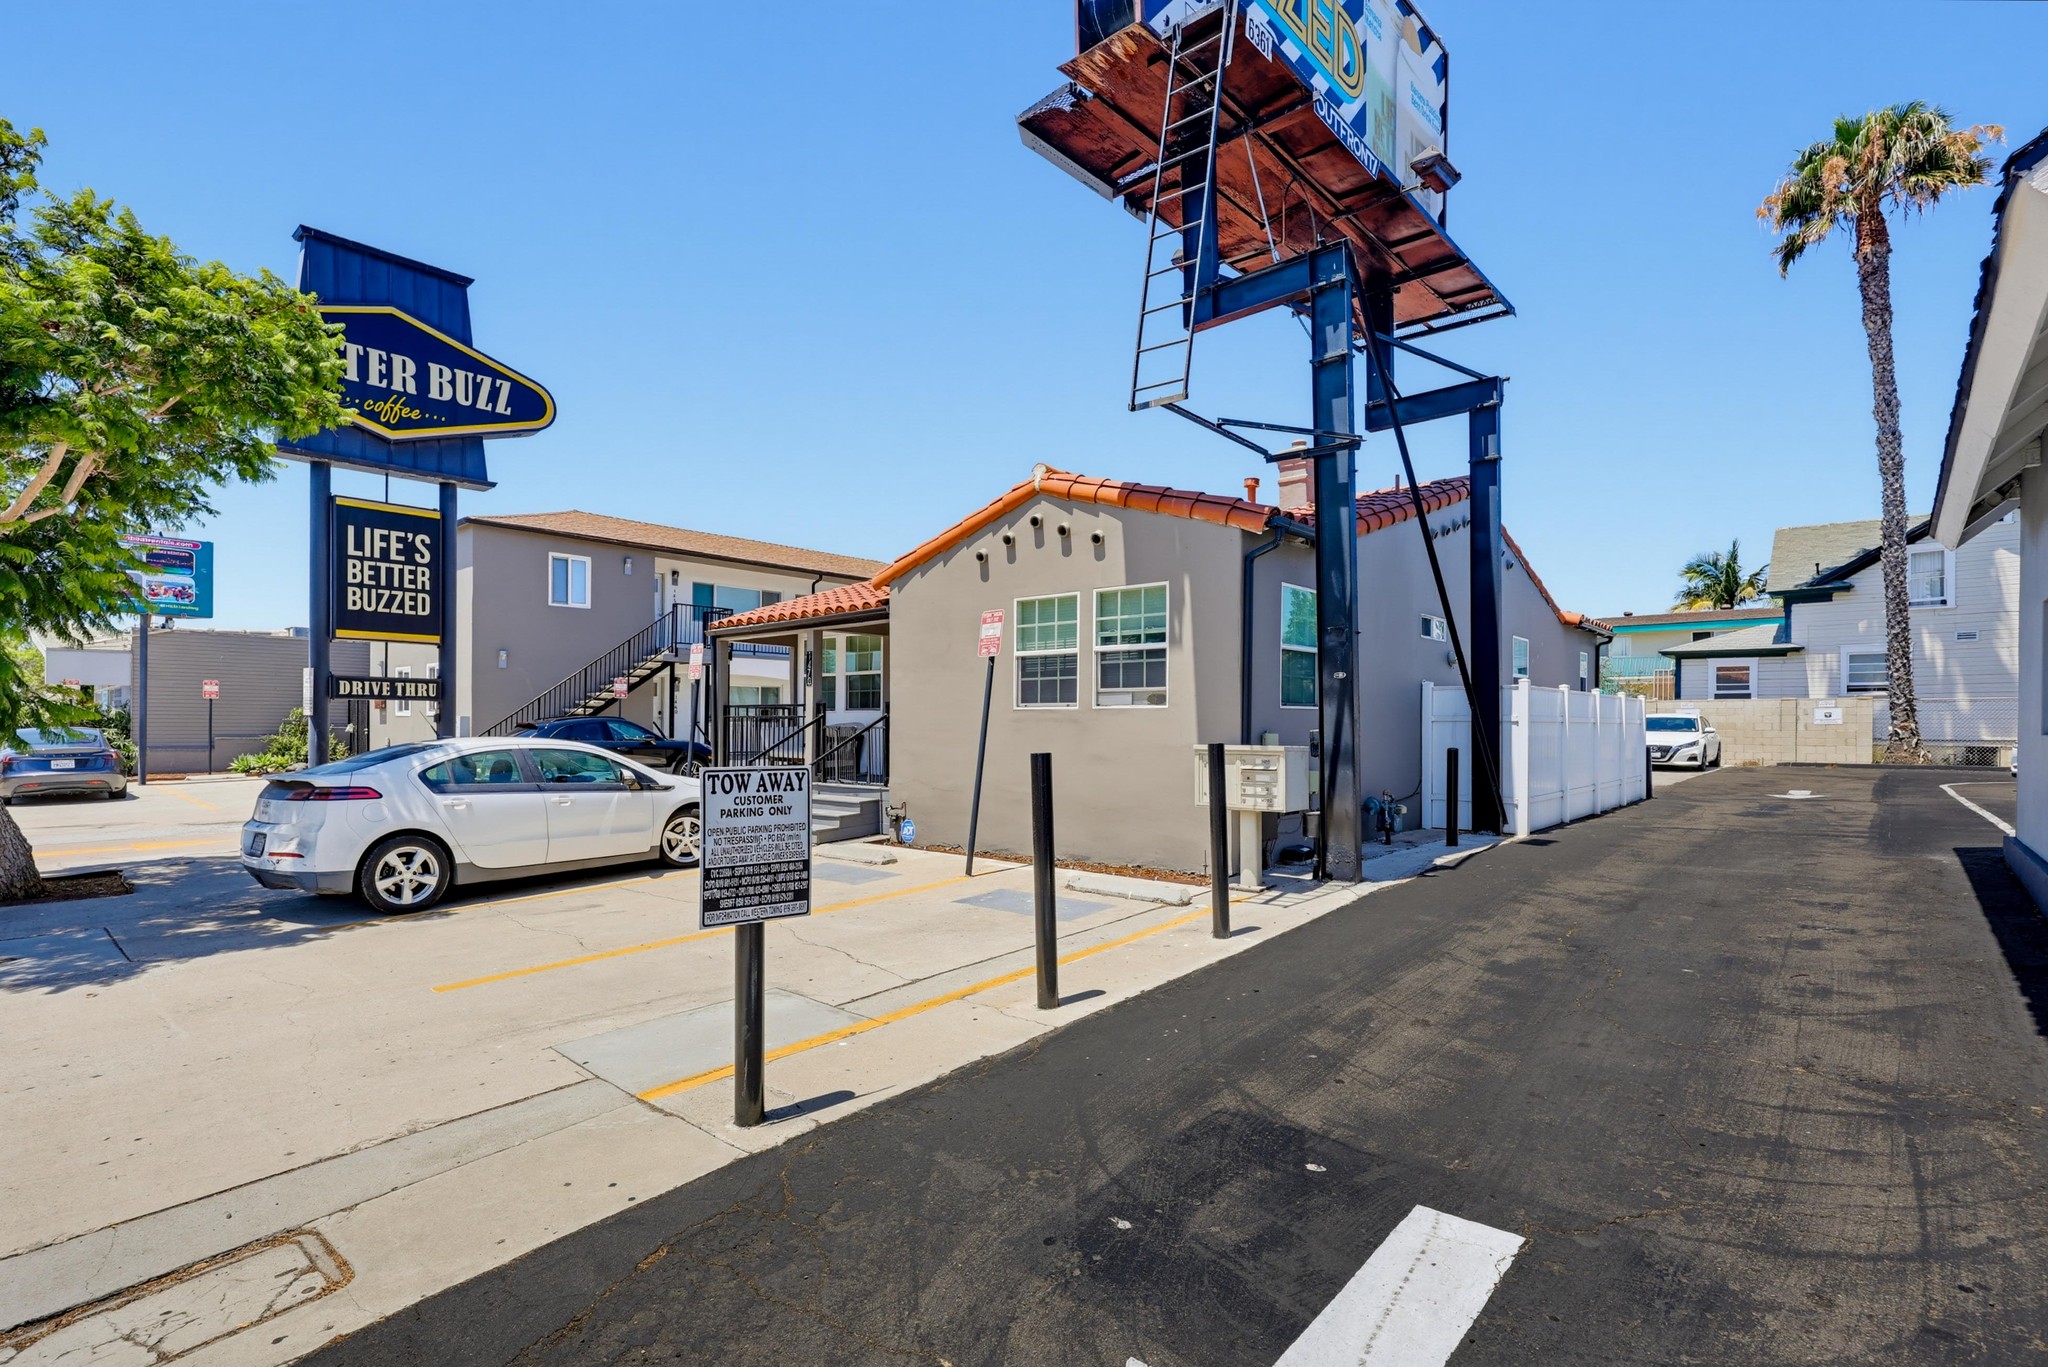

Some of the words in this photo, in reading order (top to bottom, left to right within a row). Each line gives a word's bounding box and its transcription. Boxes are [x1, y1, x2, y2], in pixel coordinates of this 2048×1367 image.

[1249, 18, 1271, 59] 6361
[340, 342, 417, 395] TER
[427, 362, 512, 416] BUZZ
[347, 525, 431, 564] LIFE'S
[347, 558, 431, 591] BETTER
[347, 586, 431, 616] BUZZED
[338, 680, 391, 696] DRIVE
[395, 682, 437, 697] THRU
[707, 773, 752, 795] TOW
[756, 772, 806, 793] AWAY
[733, 794, 784, 806] CUSTOMER
[720, 806, 764, 819] PARKING
[768, 805, 793, 816] ONLY
[707, 828, 724, 837] OPEN
[726, 826, 746, 836] PUBLIC
[747, 824, 772, 834] PARKING
[774, 822, 806, 832] PROHIBITED
[714, 838, 722, 846] NO
[724, 835, 763, 846] TRESPASSING
